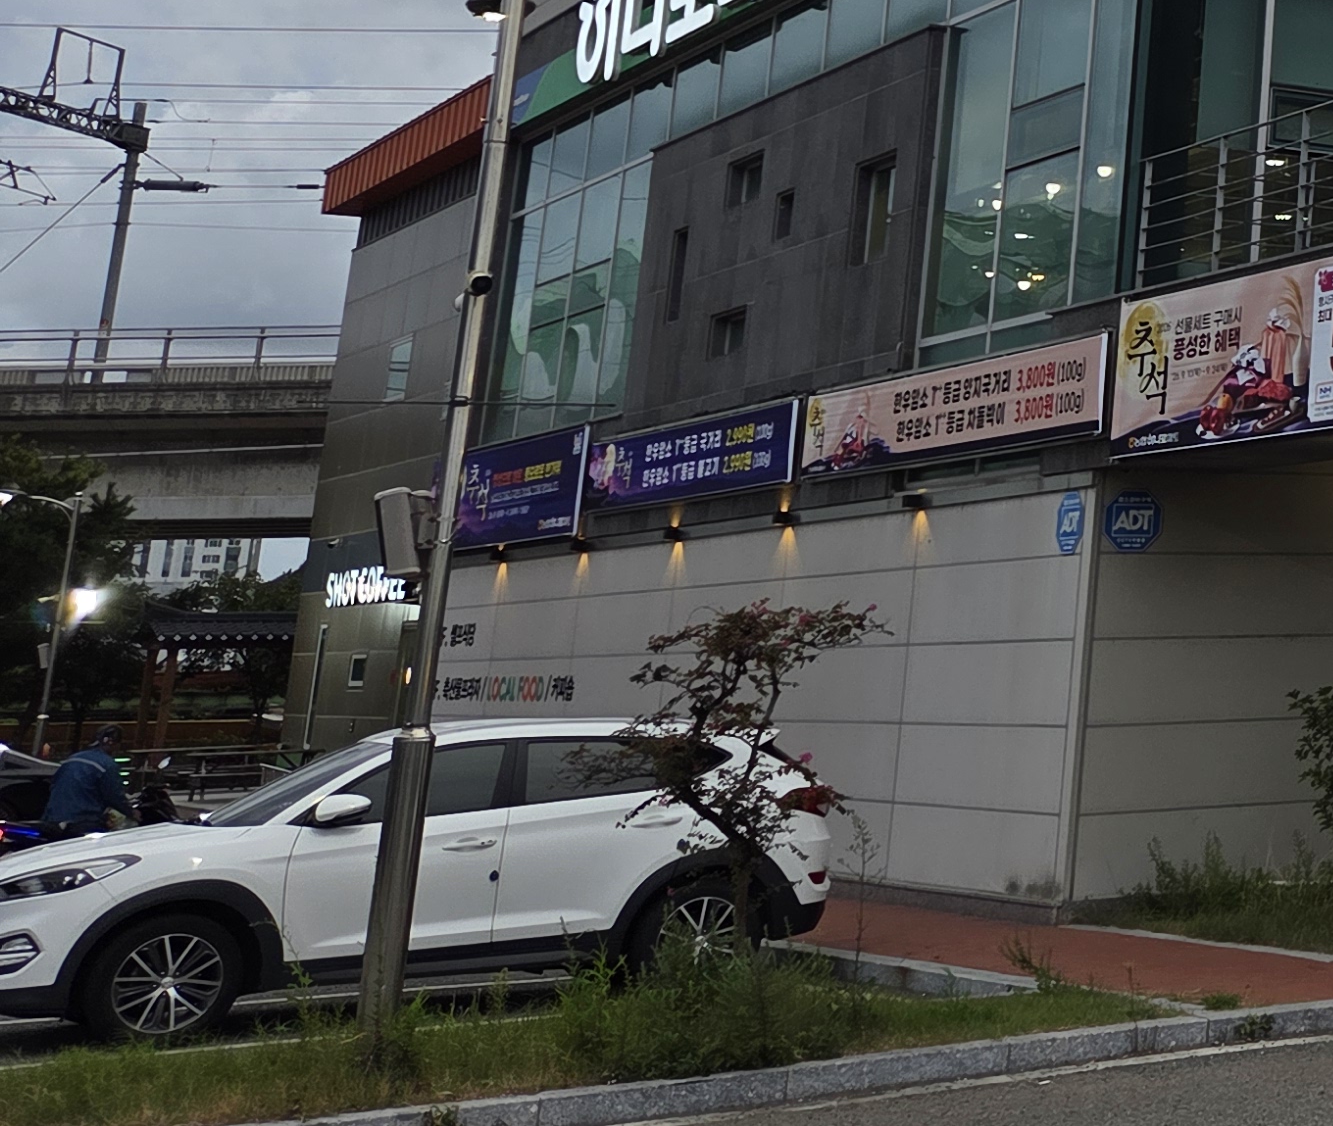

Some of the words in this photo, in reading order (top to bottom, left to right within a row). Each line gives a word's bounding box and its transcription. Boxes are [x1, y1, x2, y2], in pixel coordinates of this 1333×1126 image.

[1174, 312, 1212, 335] 선물세트
[1213, 306, 1242, 328] 구매시
[1173, 333, 1211, 361] 풍성한
[1214, 326, 1241, 352] 혜택
[893, 386, 928, 414] 한우암소
[963, 369, 1011, 401] 양지국거리
[1016, 361, 1056, 393] 3,800원
[1056, 357, 1086, 385] (100g)
[1127, 321, 1169, 415] 추석
[809, 406, 825, 457] 추석
[896, 416, 931, 442] 한우암소
[966, 401, 1006, 430] 차돌박이
[1014, 393, 1054, 424] 3,800원
[1055, 388, 1085, 416] (100g)
[616, 446, 633, 489] 추석
[466, 464, 491, 521] 추석
[1060, 510, 1080, 534] ADT
[1112, 509, 1154, 531] ADT
[487, 675, 516, 702] LOCAL
[517, 675, 544, 703] FOOD
